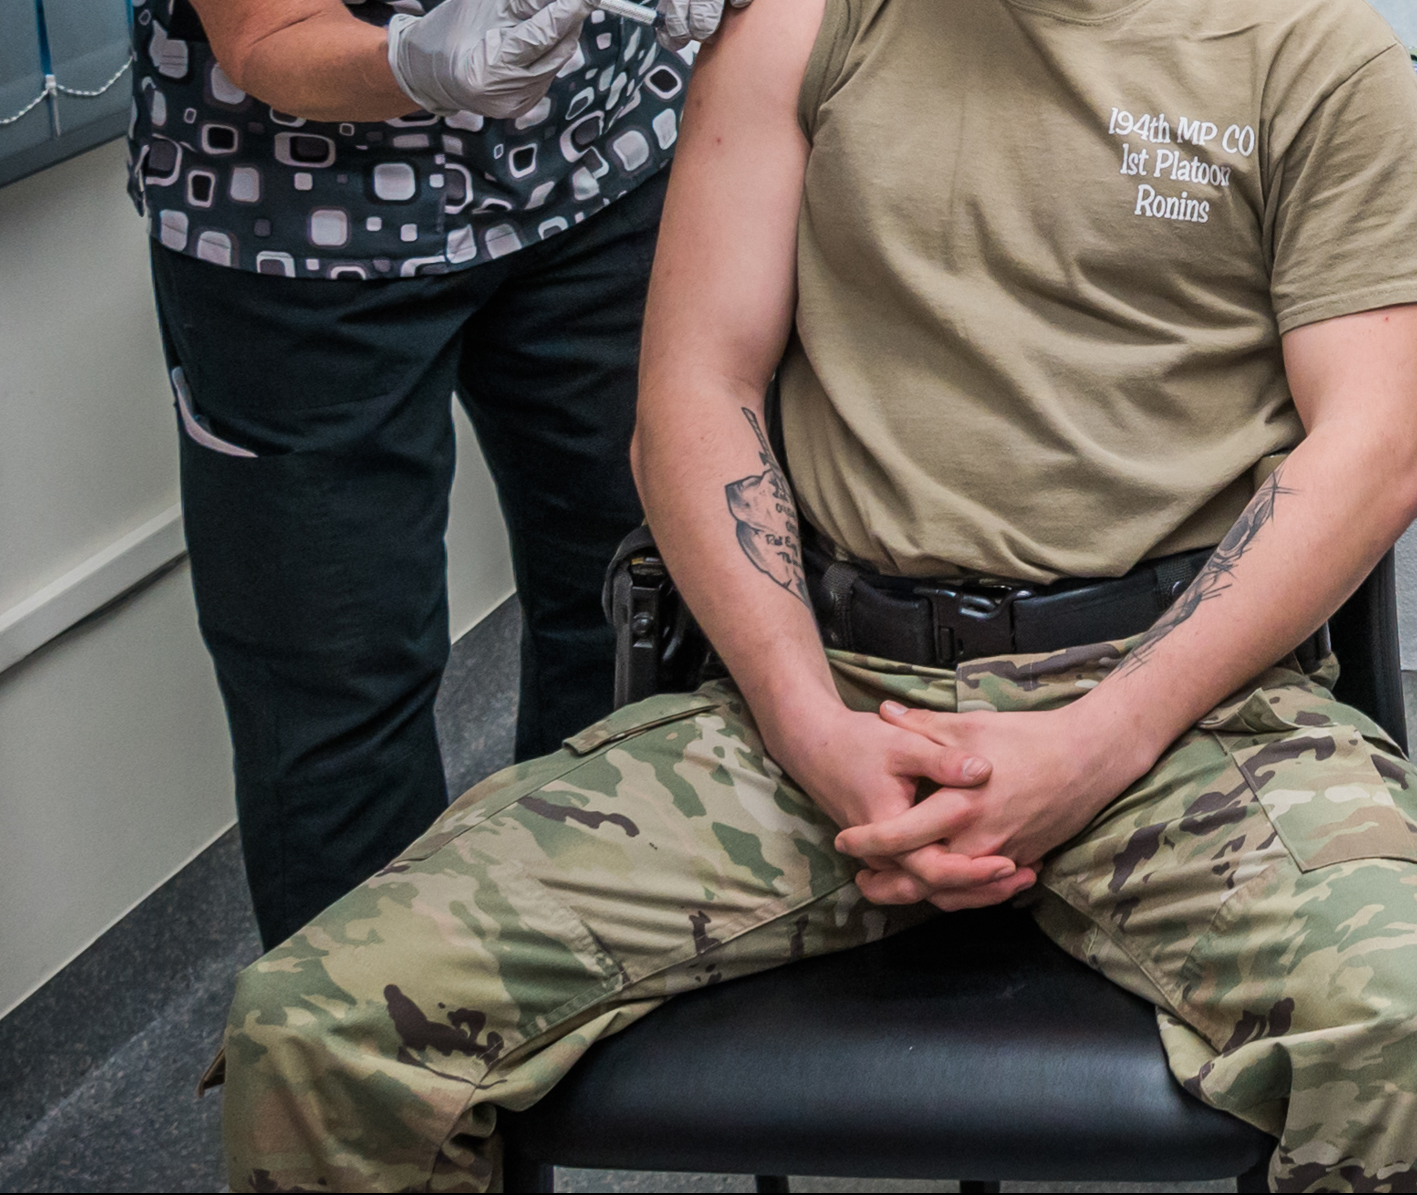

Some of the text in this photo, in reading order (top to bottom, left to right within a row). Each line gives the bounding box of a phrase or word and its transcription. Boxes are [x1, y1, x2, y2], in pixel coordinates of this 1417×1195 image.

[1108, 107, 1255, 156] 194th MP CO
[1120, 143, 1231, 186] 1st Platoon
[1134, 184, 1210, 223] Ronins
